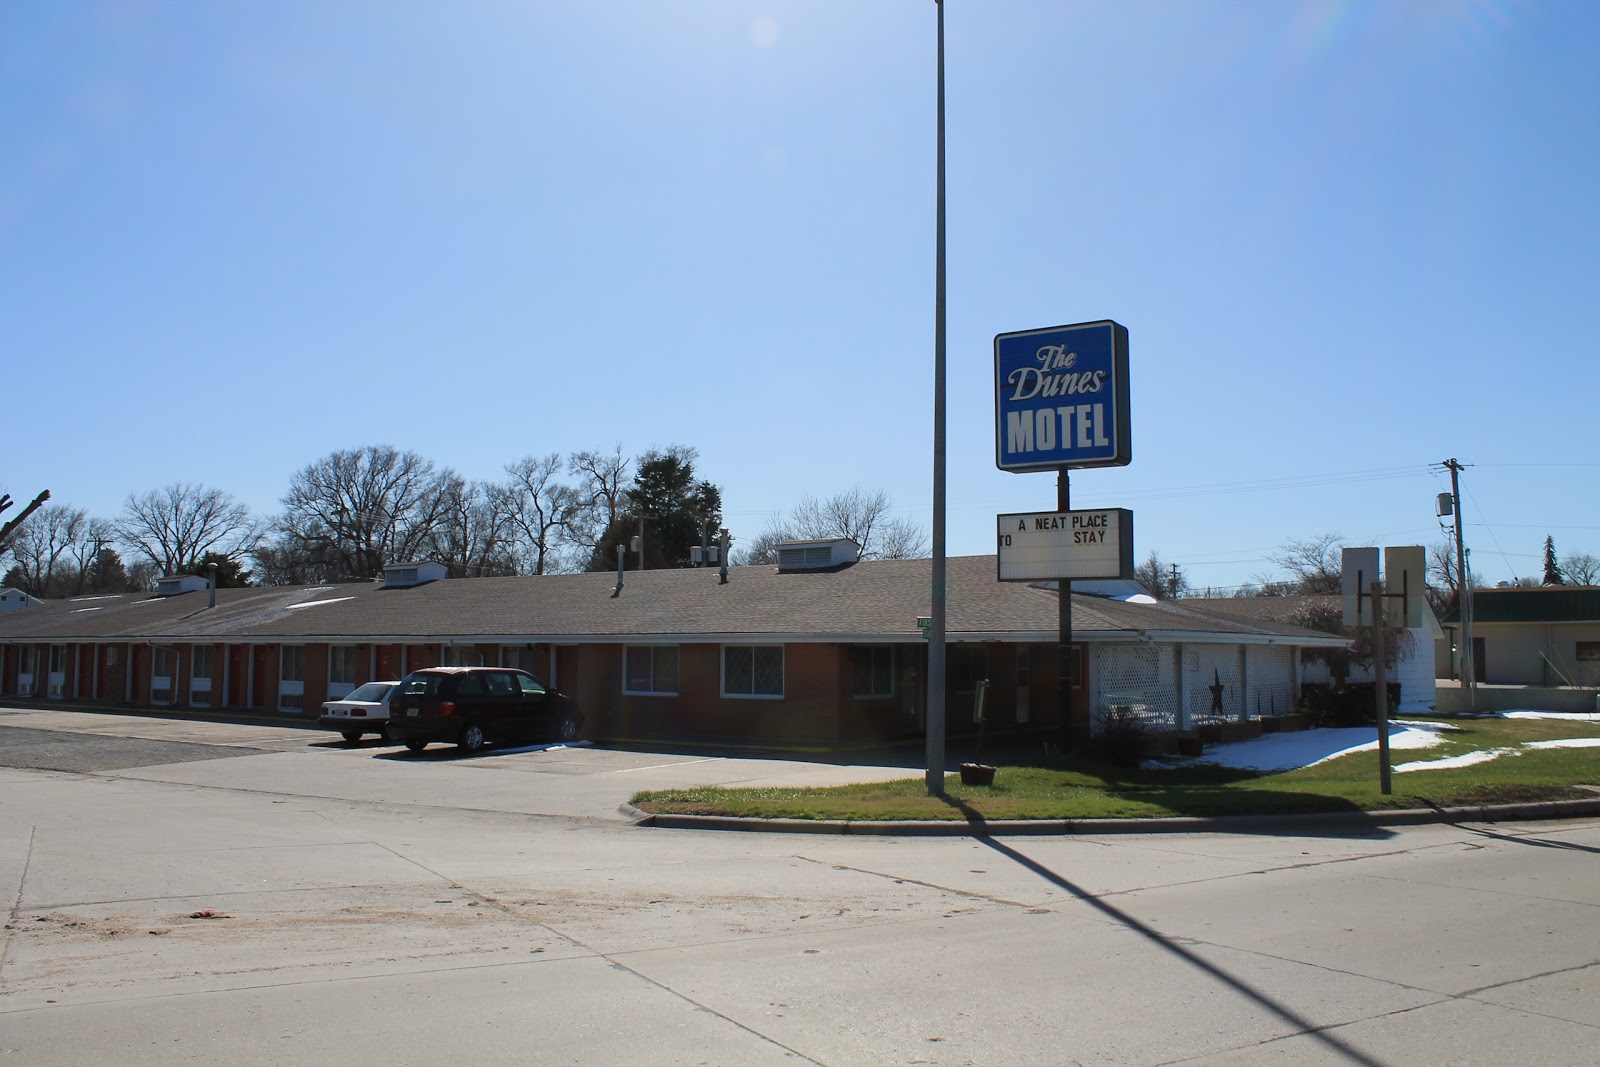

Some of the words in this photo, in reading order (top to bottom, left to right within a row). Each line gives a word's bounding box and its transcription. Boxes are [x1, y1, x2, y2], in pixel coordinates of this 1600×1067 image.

[1036, 344, 1076, 372] The
[1007, 367, 1105, 401] Dunes
[1007, 403, 1109, 454] MOTEL
[1018, 519, 1026, 531] A
[1035, 517, 1066, 530] NEAT
[1072, 515, 1108, 528] PLACE
[1074, 530, 1105, 544] STAY
